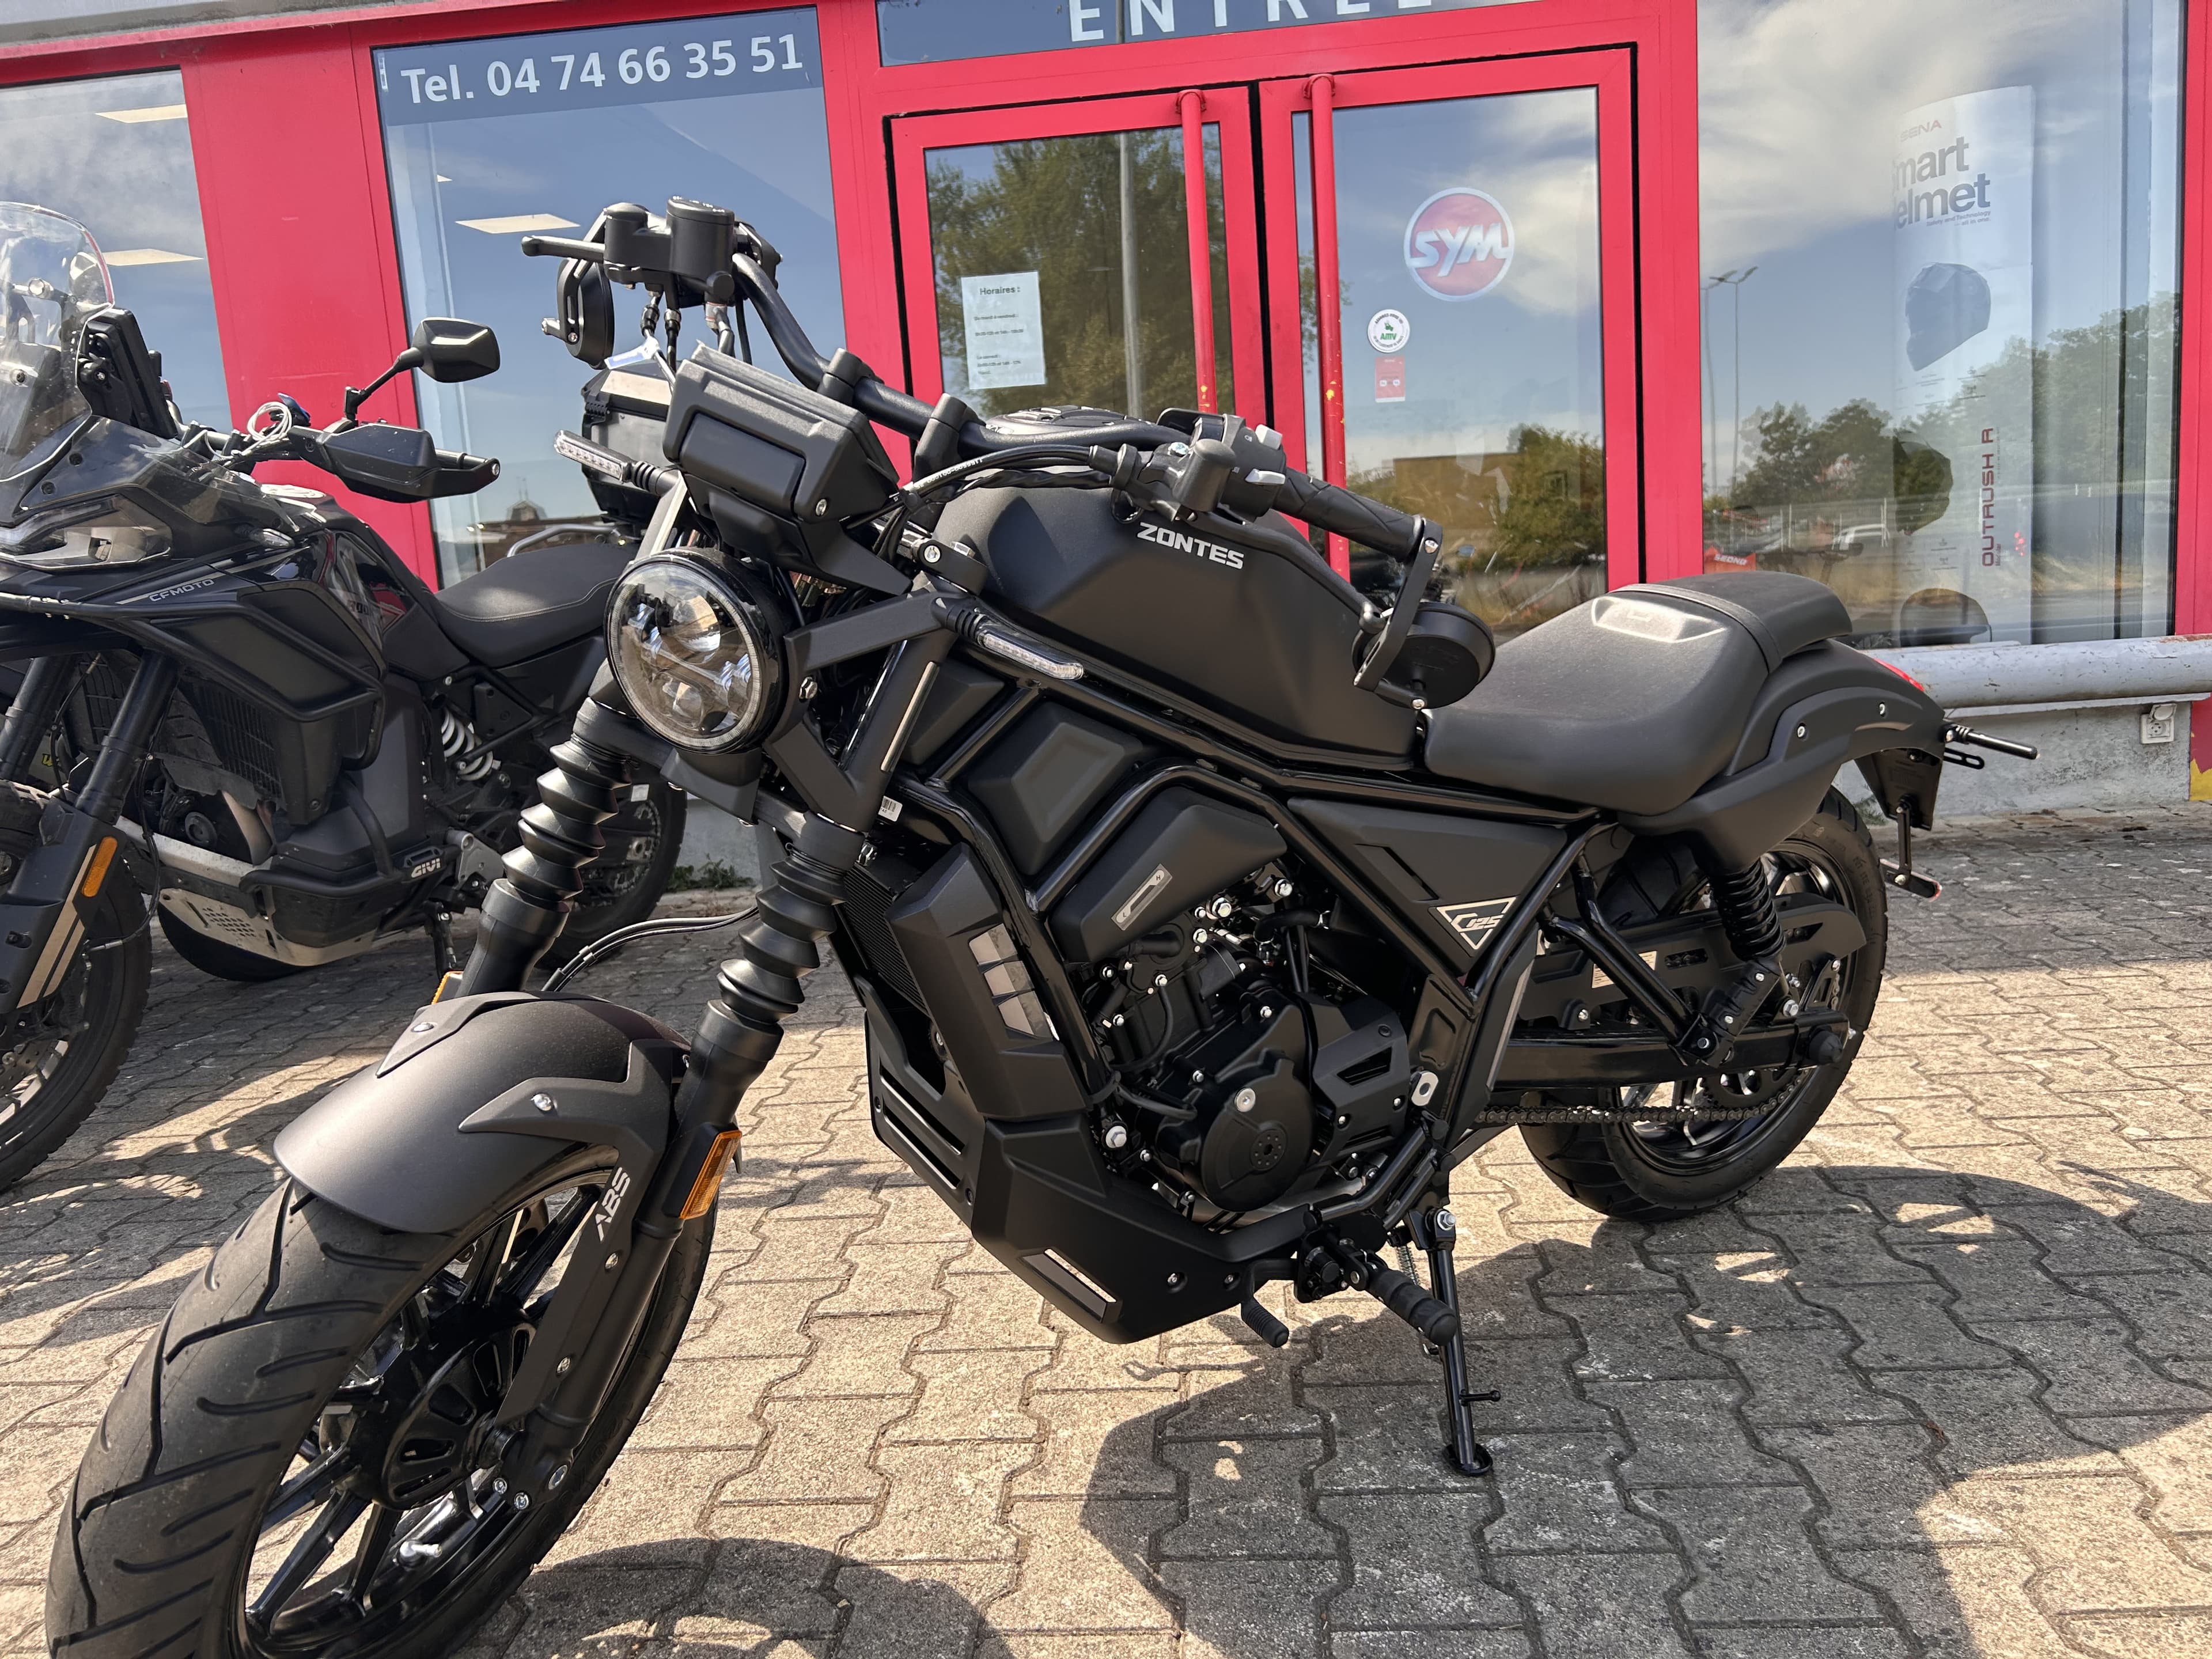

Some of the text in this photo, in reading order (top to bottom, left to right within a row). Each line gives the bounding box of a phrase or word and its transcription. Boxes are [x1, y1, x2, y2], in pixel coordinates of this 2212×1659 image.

[400, 34, 802, 104] Tel. 04 74 66 35 51
[1900, 120, 1942, 142] SENA
[1411, 223, 1510, 277] SYM
[980, 287, 1015, 295] Horaires
[1982, 454, 1994, 566] OUTRUSH
[1137, 522, 1244, 569] ZONTES
[150, 579, 214, 601] CFMOTO
[411, 858, 441, 878] GIVI
[595, 1166, 631, 1243] ABS
